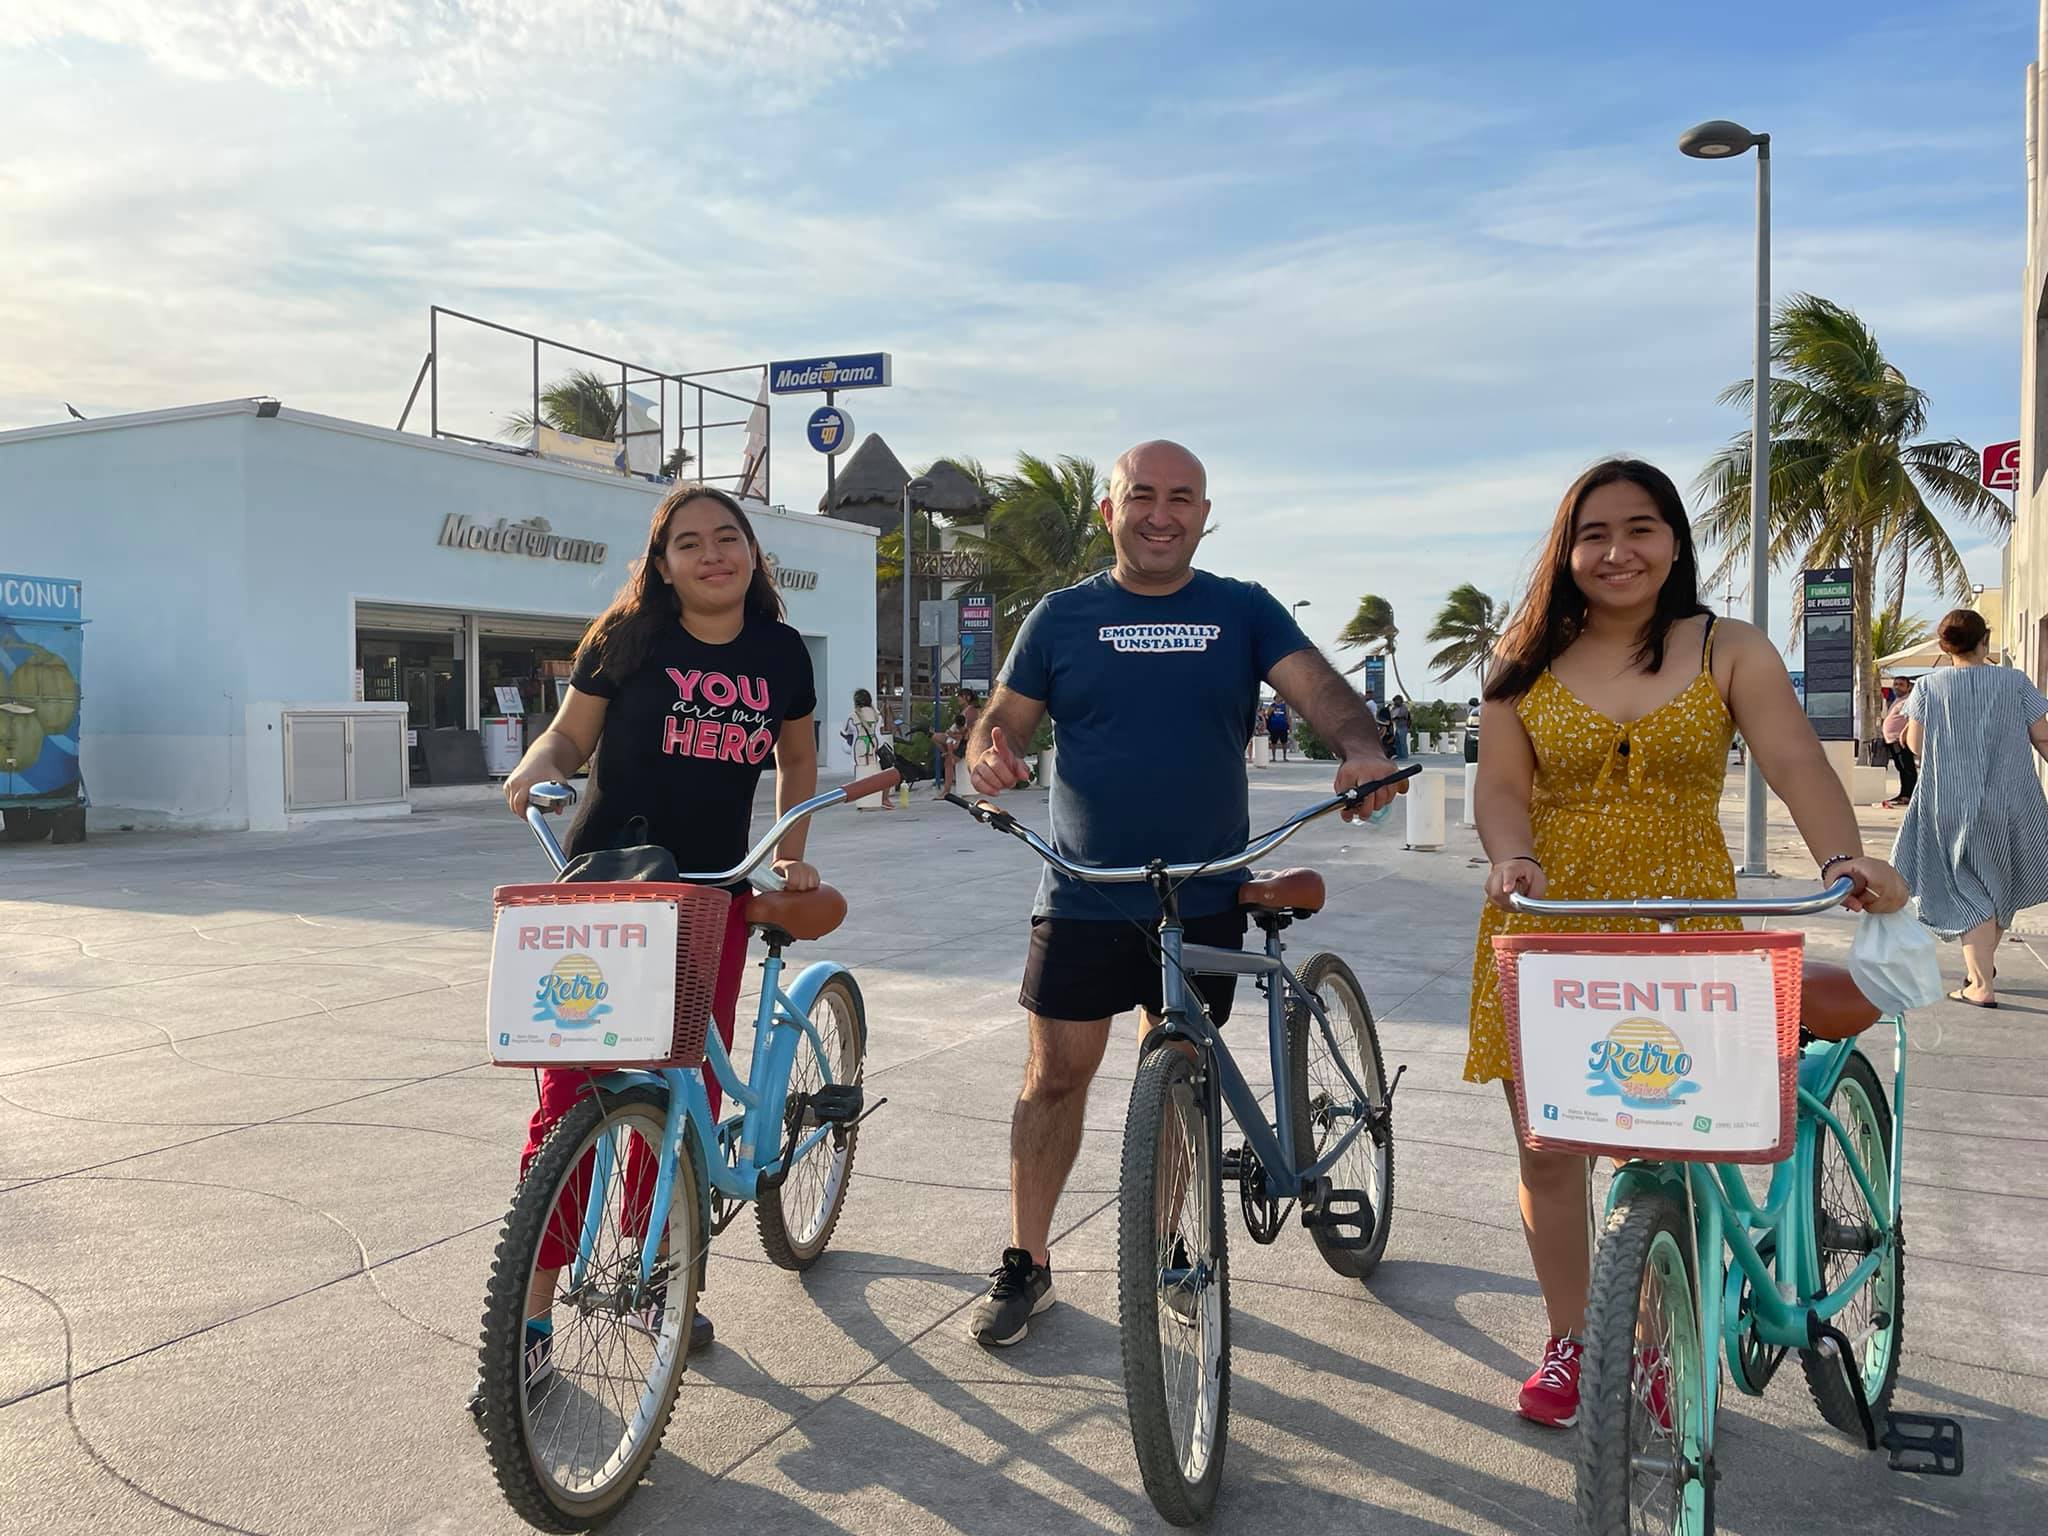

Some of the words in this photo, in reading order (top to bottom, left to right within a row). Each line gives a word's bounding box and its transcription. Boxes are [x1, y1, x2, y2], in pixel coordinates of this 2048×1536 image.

[0, 580, 80, 608] CONUT
[1101, 625, 1218, 639] EMOTIONALLY
[1117, 638, 1205, 649] UNSTABLE
[665, 668, 770, 711] YOU
[672, 701, 725, 719] are
[732, 709, 773, 738] my
[663, 715, 773, 764] HERO
[518, 924, 647, 950] RENTA
[536, 973, 609, 1006] Retro
[1553, 979, 1738, 1011] RENTA
[1588, 1040, 1692, 1080] Retro
